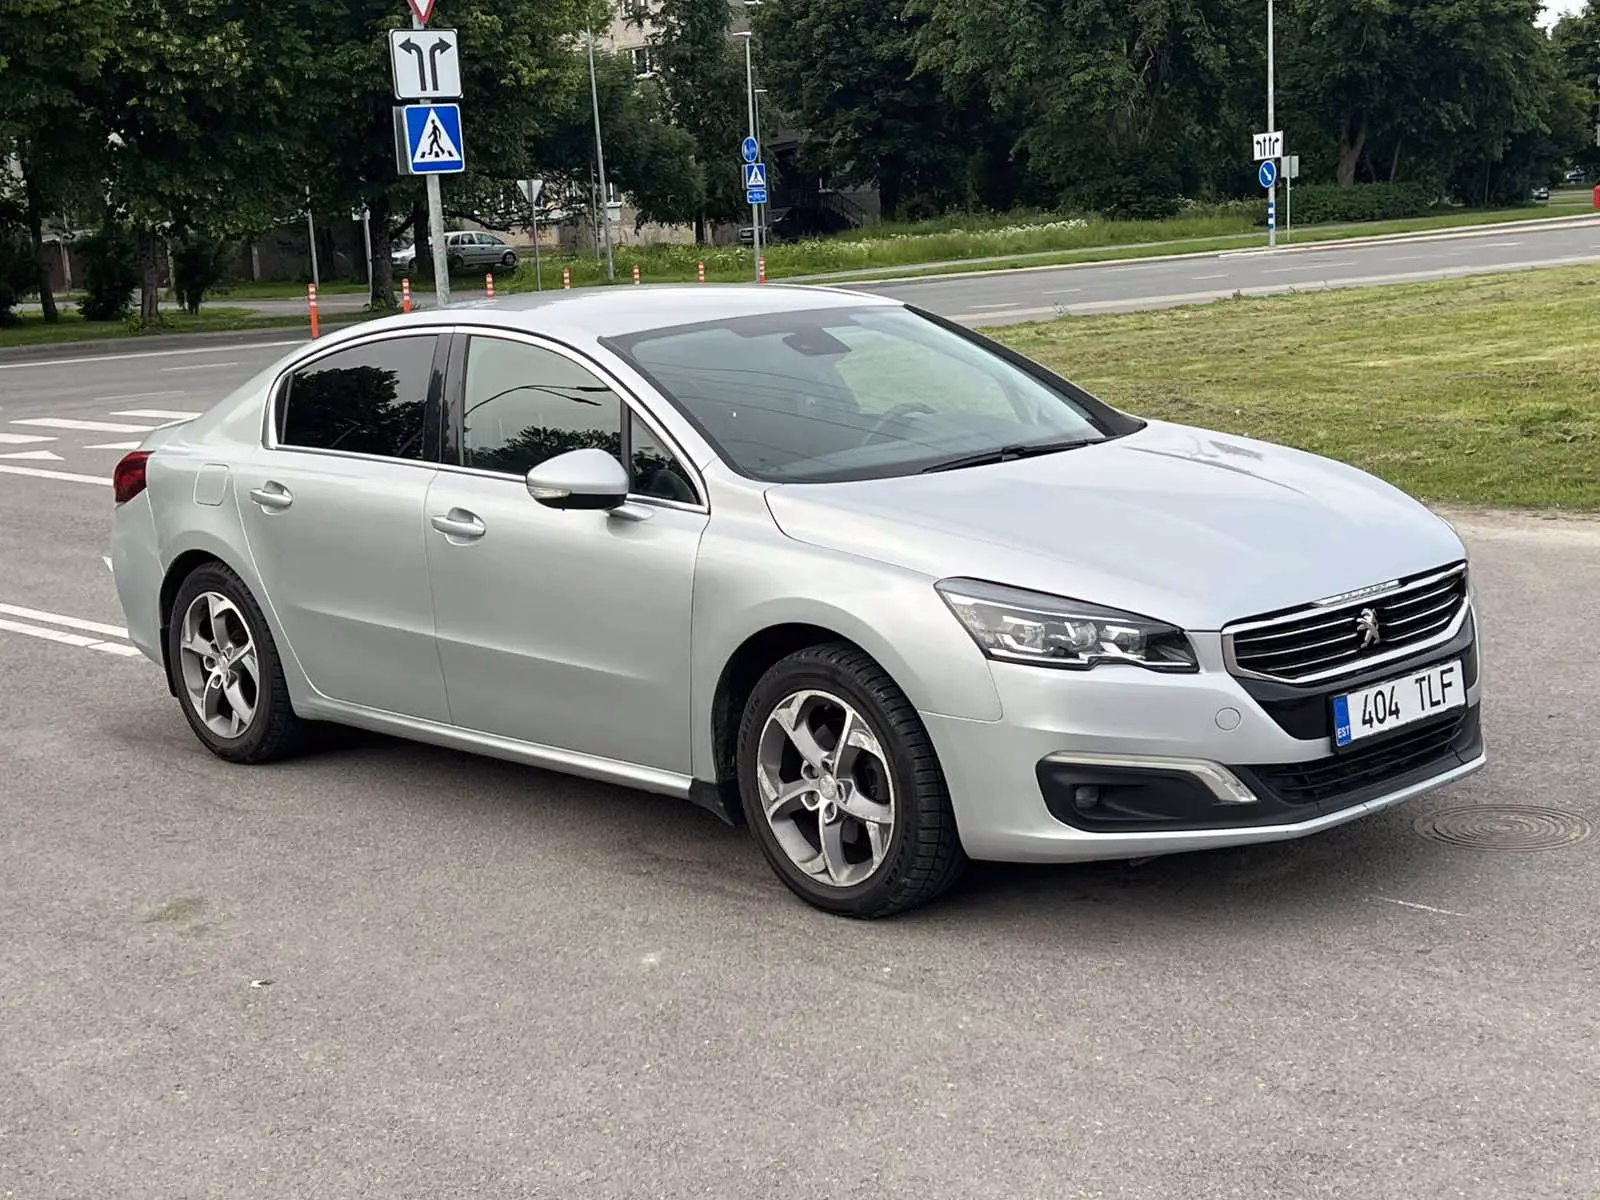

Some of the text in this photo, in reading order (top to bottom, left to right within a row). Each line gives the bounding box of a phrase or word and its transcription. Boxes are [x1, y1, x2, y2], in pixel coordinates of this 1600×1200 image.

[1362, 667, 1454, 728] 404 TLF
[1337, 725, 1350, 738] EST
